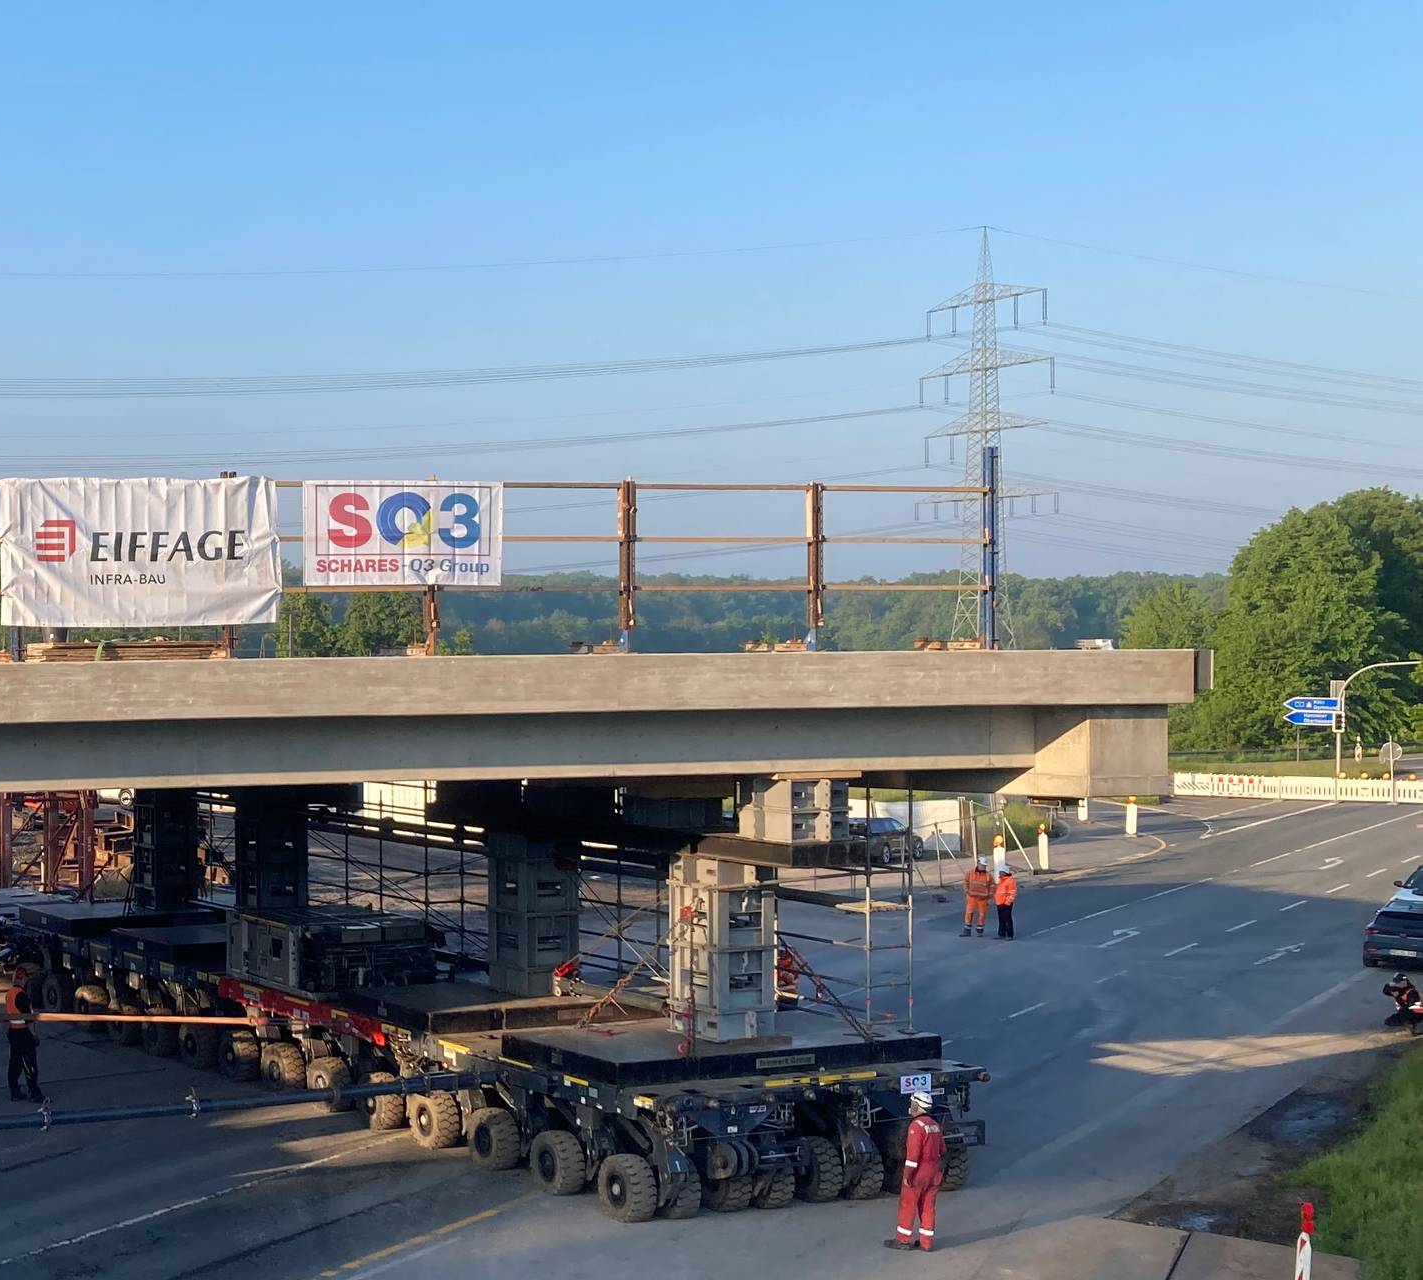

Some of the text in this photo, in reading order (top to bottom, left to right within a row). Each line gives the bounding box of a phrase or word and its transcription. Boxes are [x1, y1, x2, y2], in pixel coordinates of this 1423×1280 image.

[327, 491, 482, 549] SQ3
[89, 530, 245, 562] EIFFAGE
[89, 573, 166, 586] INFRA-BAU
[439, 558, 490, 576] Group
